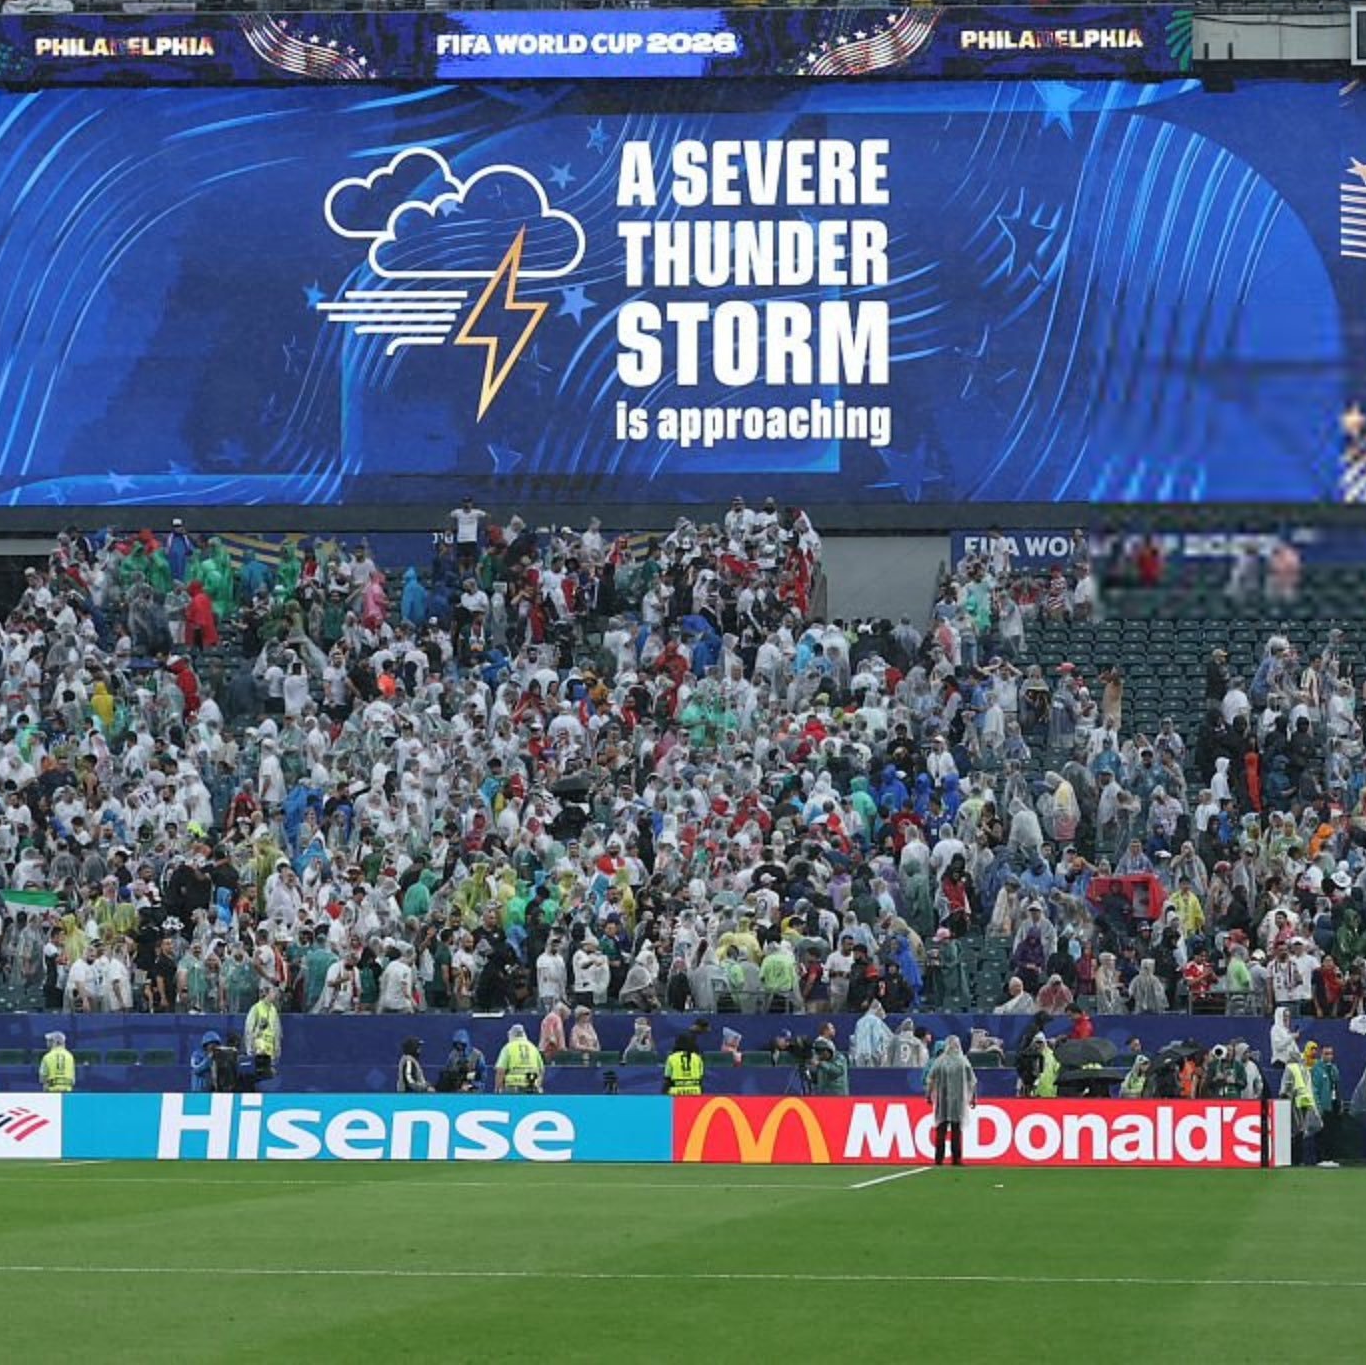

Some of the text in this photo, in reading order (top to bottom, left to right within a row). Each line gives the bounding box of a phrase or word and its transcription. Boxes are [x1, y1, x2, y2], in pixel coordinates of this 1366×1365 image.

[436, 32, 738, 55] FIFA WORLD CUP 2026
[616, 139, 890, 207] A SEVERE
[618, 220, 889, 287] THUNDER
[616, 300, 890, 388] STORM
[616, 399, 892, 448] is approaching
[157, 1092, 576, 1161] Hisense
[843, 1102, 1264, 1162] McDonald's
